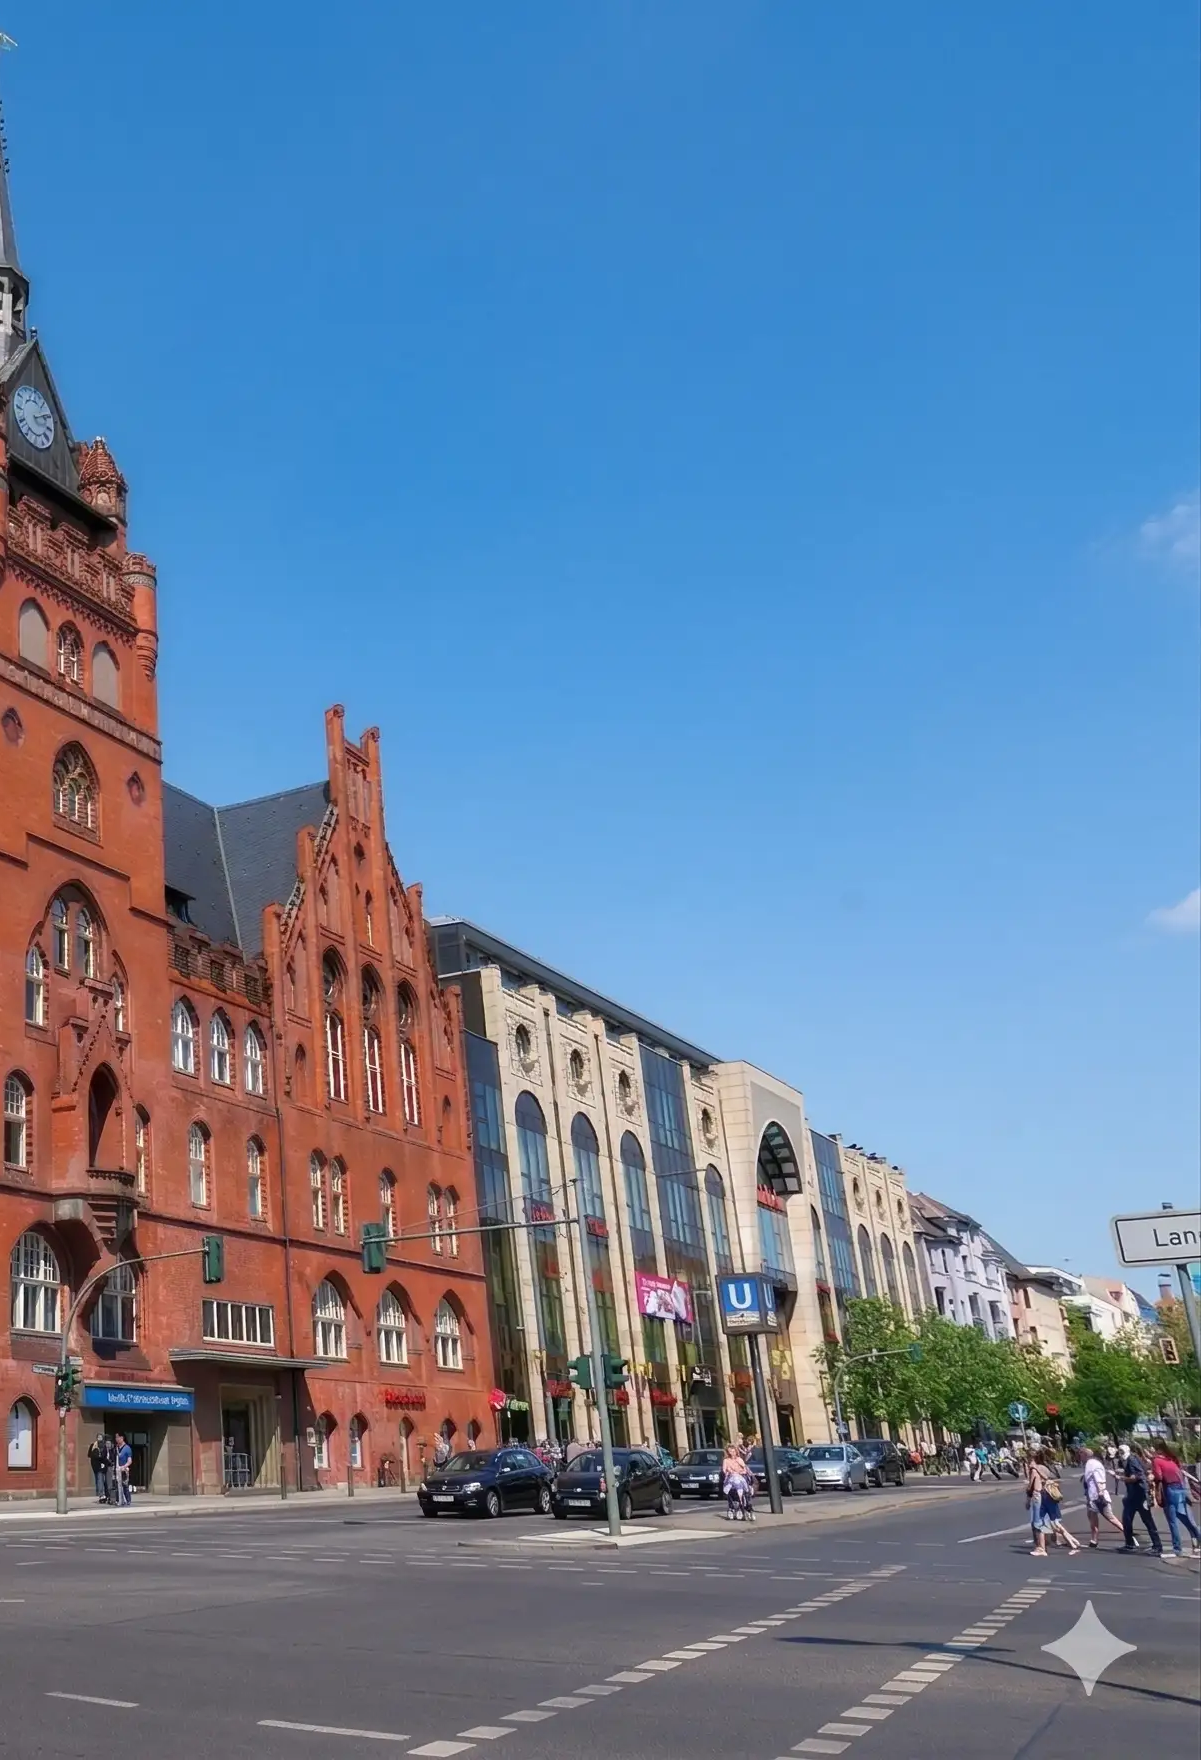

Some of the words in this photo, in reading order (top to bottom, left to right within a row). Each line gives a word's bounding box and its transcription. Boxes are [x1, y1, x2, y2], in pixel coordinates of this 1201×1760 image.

[1152, 1228, 1201, 1247] Lan
[728, 1282, 752, 1309] U
[763, 1283, 773, 1308] U
